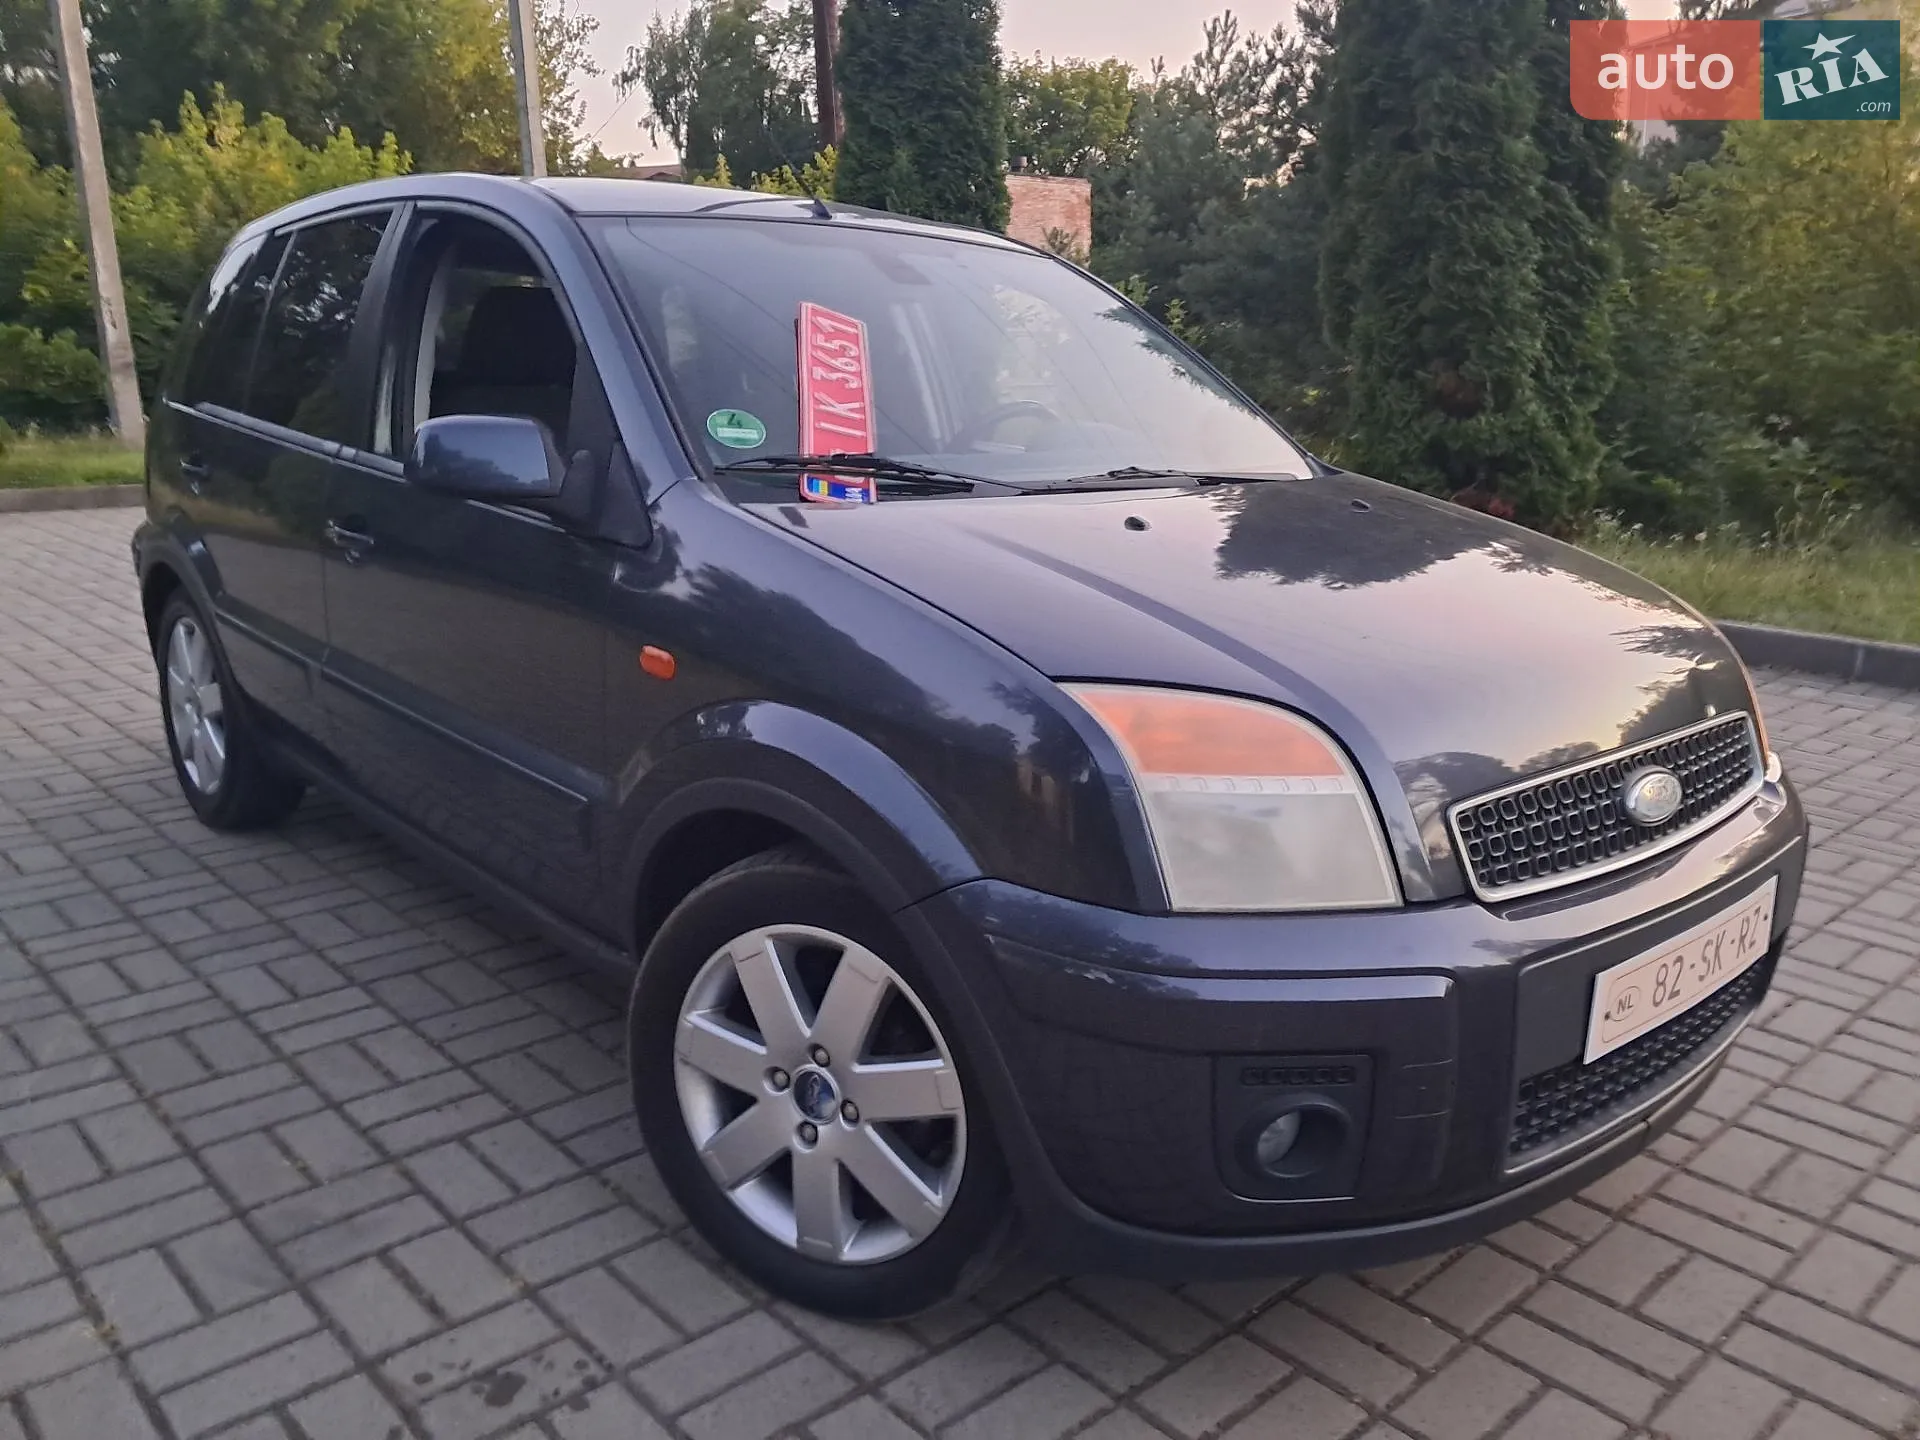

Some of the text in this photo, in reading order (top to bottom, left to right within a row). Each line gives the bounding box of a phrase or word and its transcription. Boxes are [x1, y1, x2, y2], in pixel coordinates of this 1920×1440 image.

[811, 315, 862, 389] 3651
[1652, 906, 1761, 1008] 82-SK-RZ
[1617, 993, 1634, 1015] NL
